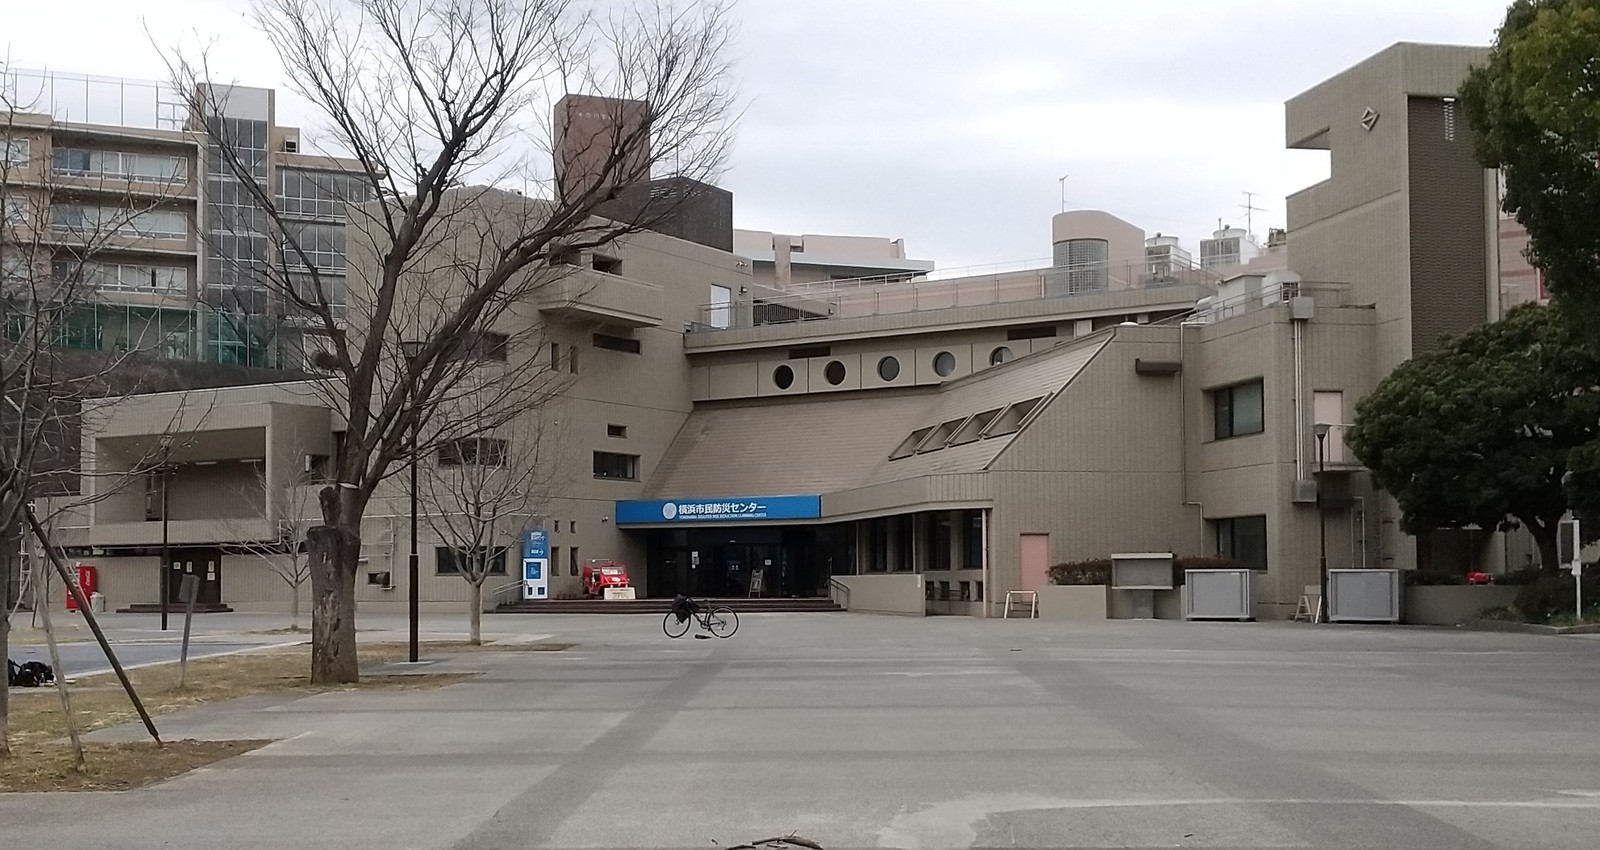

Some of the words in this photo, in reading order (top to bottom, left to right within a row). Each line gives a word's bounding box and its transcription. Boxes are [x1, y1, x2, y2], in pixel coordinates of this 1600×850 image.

[679, 503, 766, 514] 横浜市民防災センター
